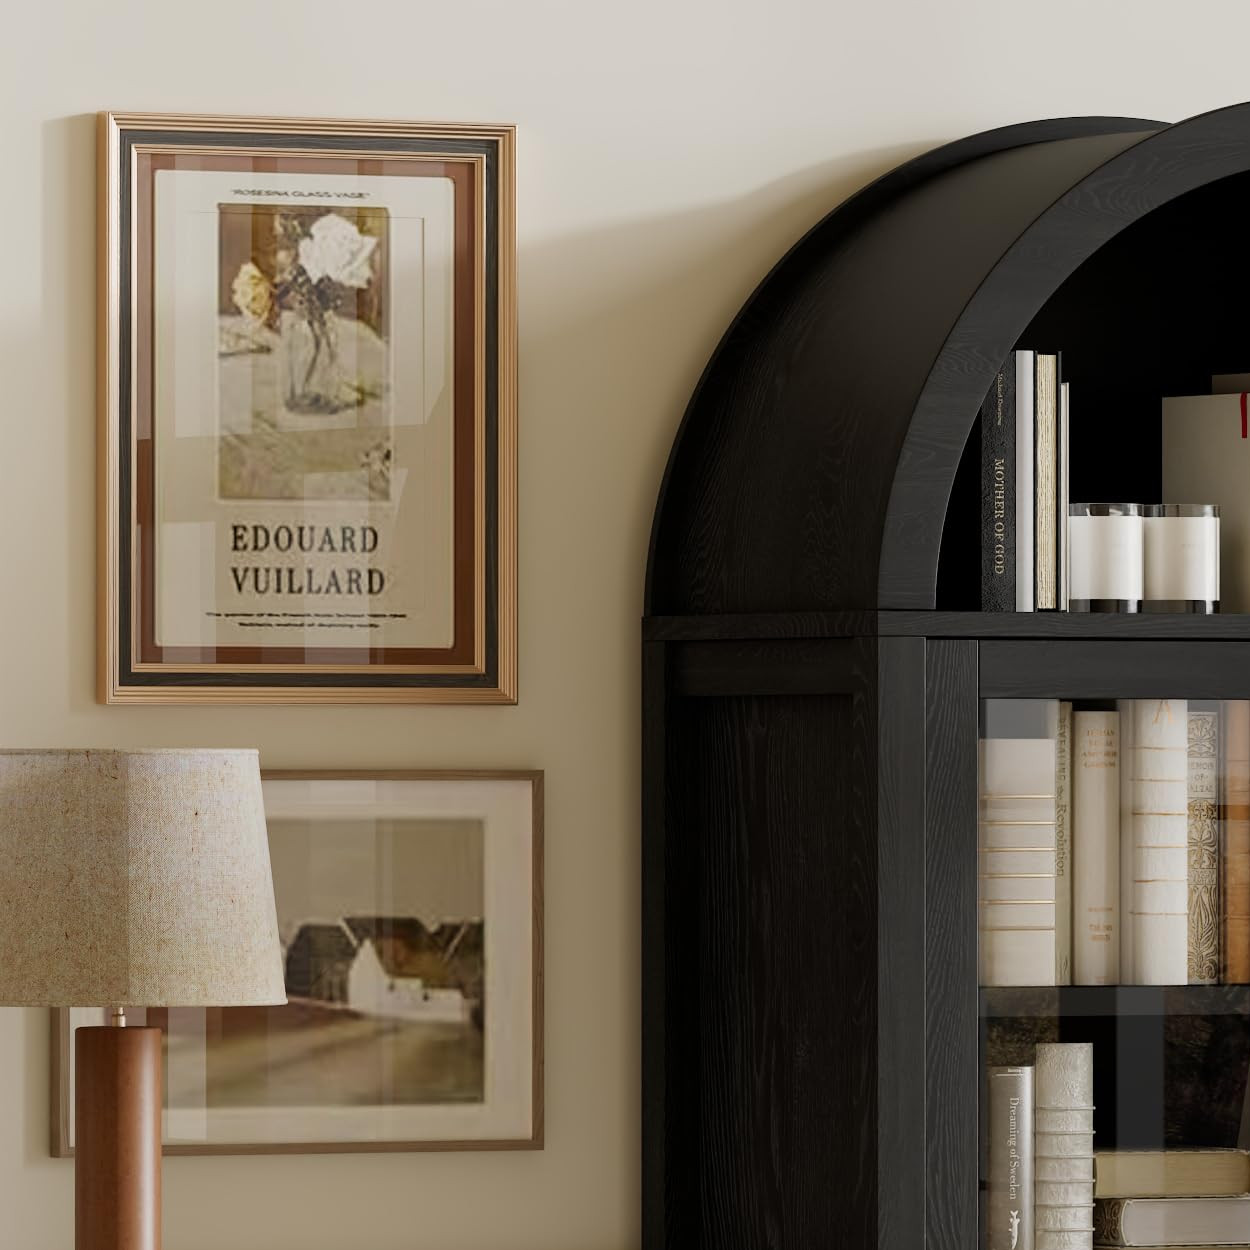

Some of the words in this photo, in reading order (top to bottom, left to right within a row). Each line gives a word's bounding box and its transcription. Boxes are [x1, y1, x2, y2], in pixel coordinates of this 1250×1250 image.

[995, 458, 1005, 518] MOTHER
[231, 524, 379, 553] EDOUARD
[995, 522, 1005, 541] OF
[995, 544, 1005, 574] GOD
[230, 566, 385, 595] VUILLARD
[1008, 1097, 1020, 1147] Dreaming
[1010, 1148, 1020, 1160] of
[1010, 1161, 1021, 1200] Sweden
